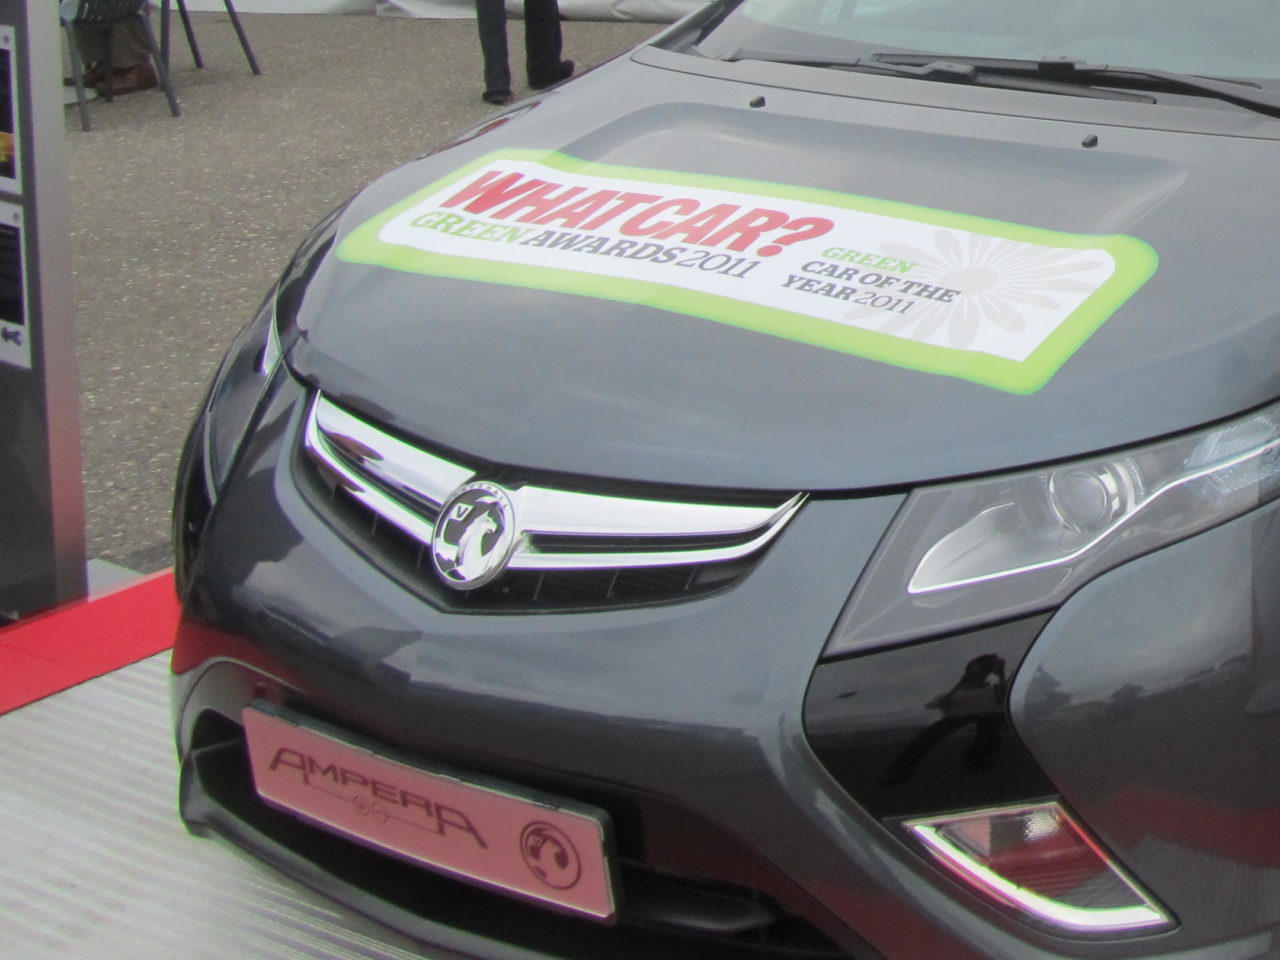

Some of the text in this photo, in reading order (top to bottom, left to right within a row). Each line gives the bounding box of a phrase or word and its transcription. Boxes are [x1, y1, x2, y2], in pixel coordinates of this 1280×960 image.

[821, 246, 919, 274] GREEN
[780, 275, 915, 315] YEAR 2011
[801, 260, 961, 304] CAR OF THE
[268, 746, 489, 850] AMPERA
